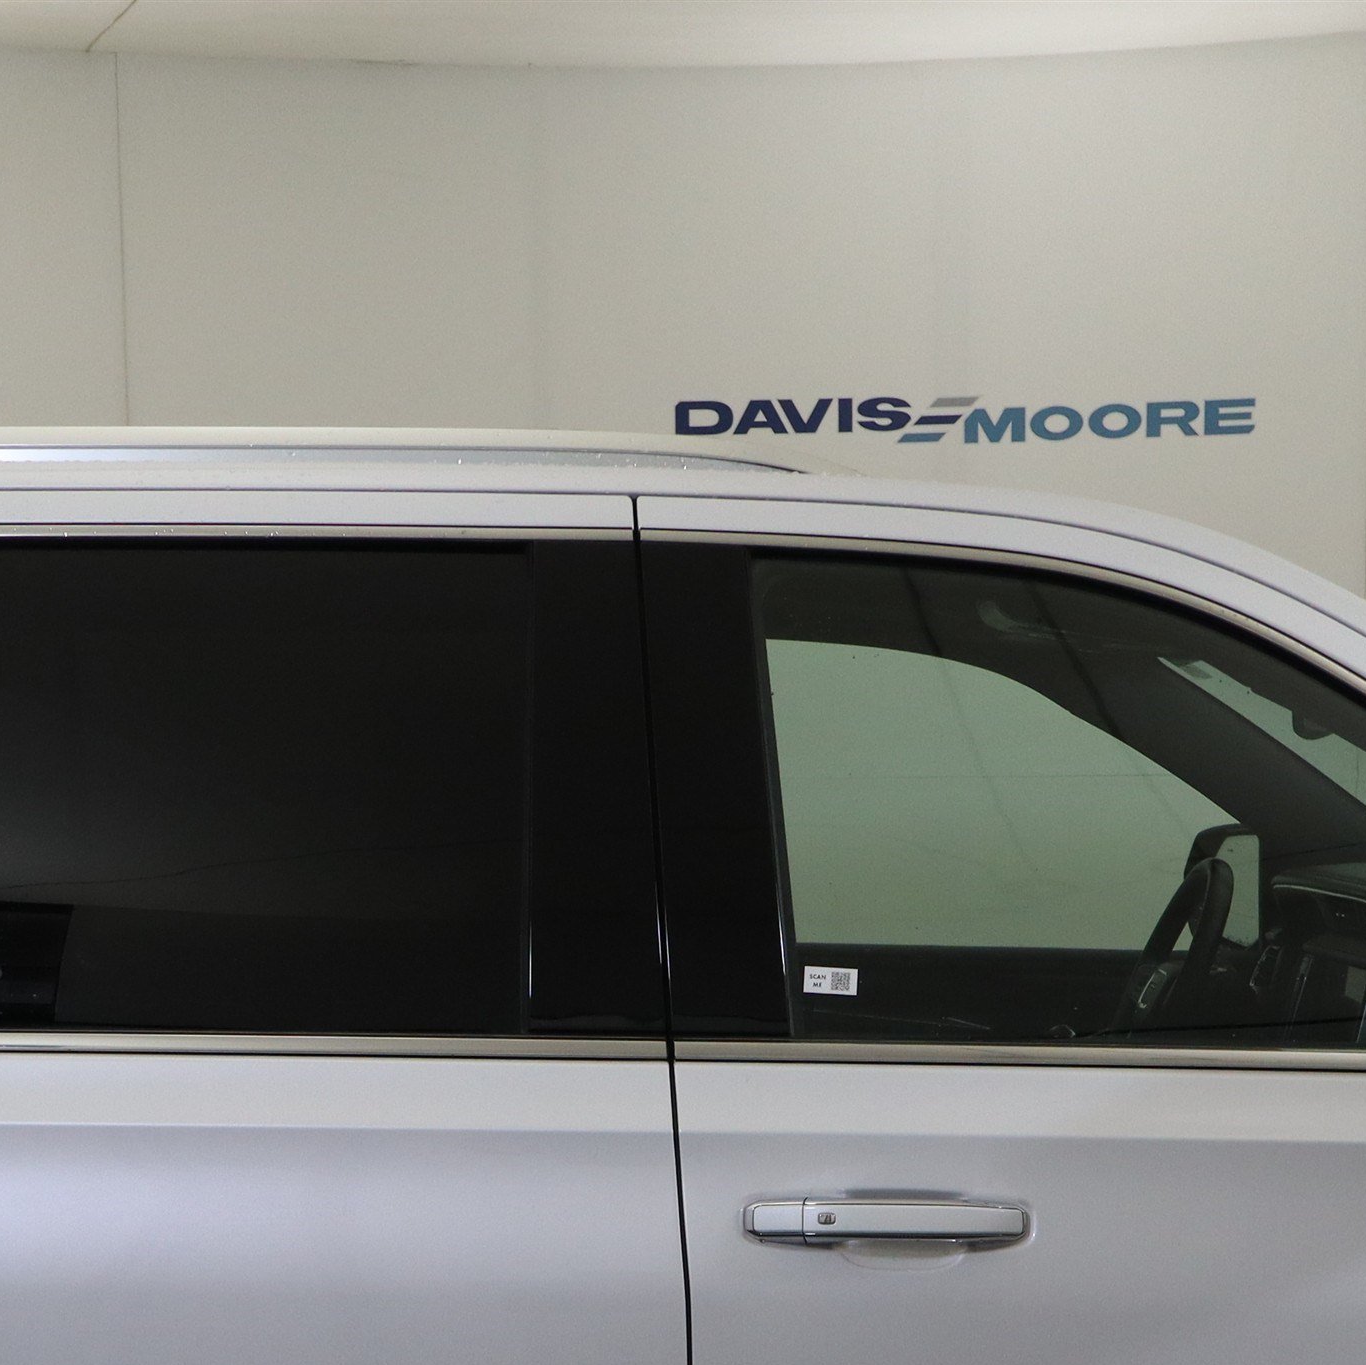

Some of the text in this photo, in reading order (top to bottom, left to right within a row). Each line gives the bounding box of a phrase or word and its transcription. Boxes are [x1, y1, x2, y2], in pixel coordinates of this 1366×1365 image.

[674, 397, 1256, 444] DAVIS MOORE
[809, 973, 827, 981] SCAN
